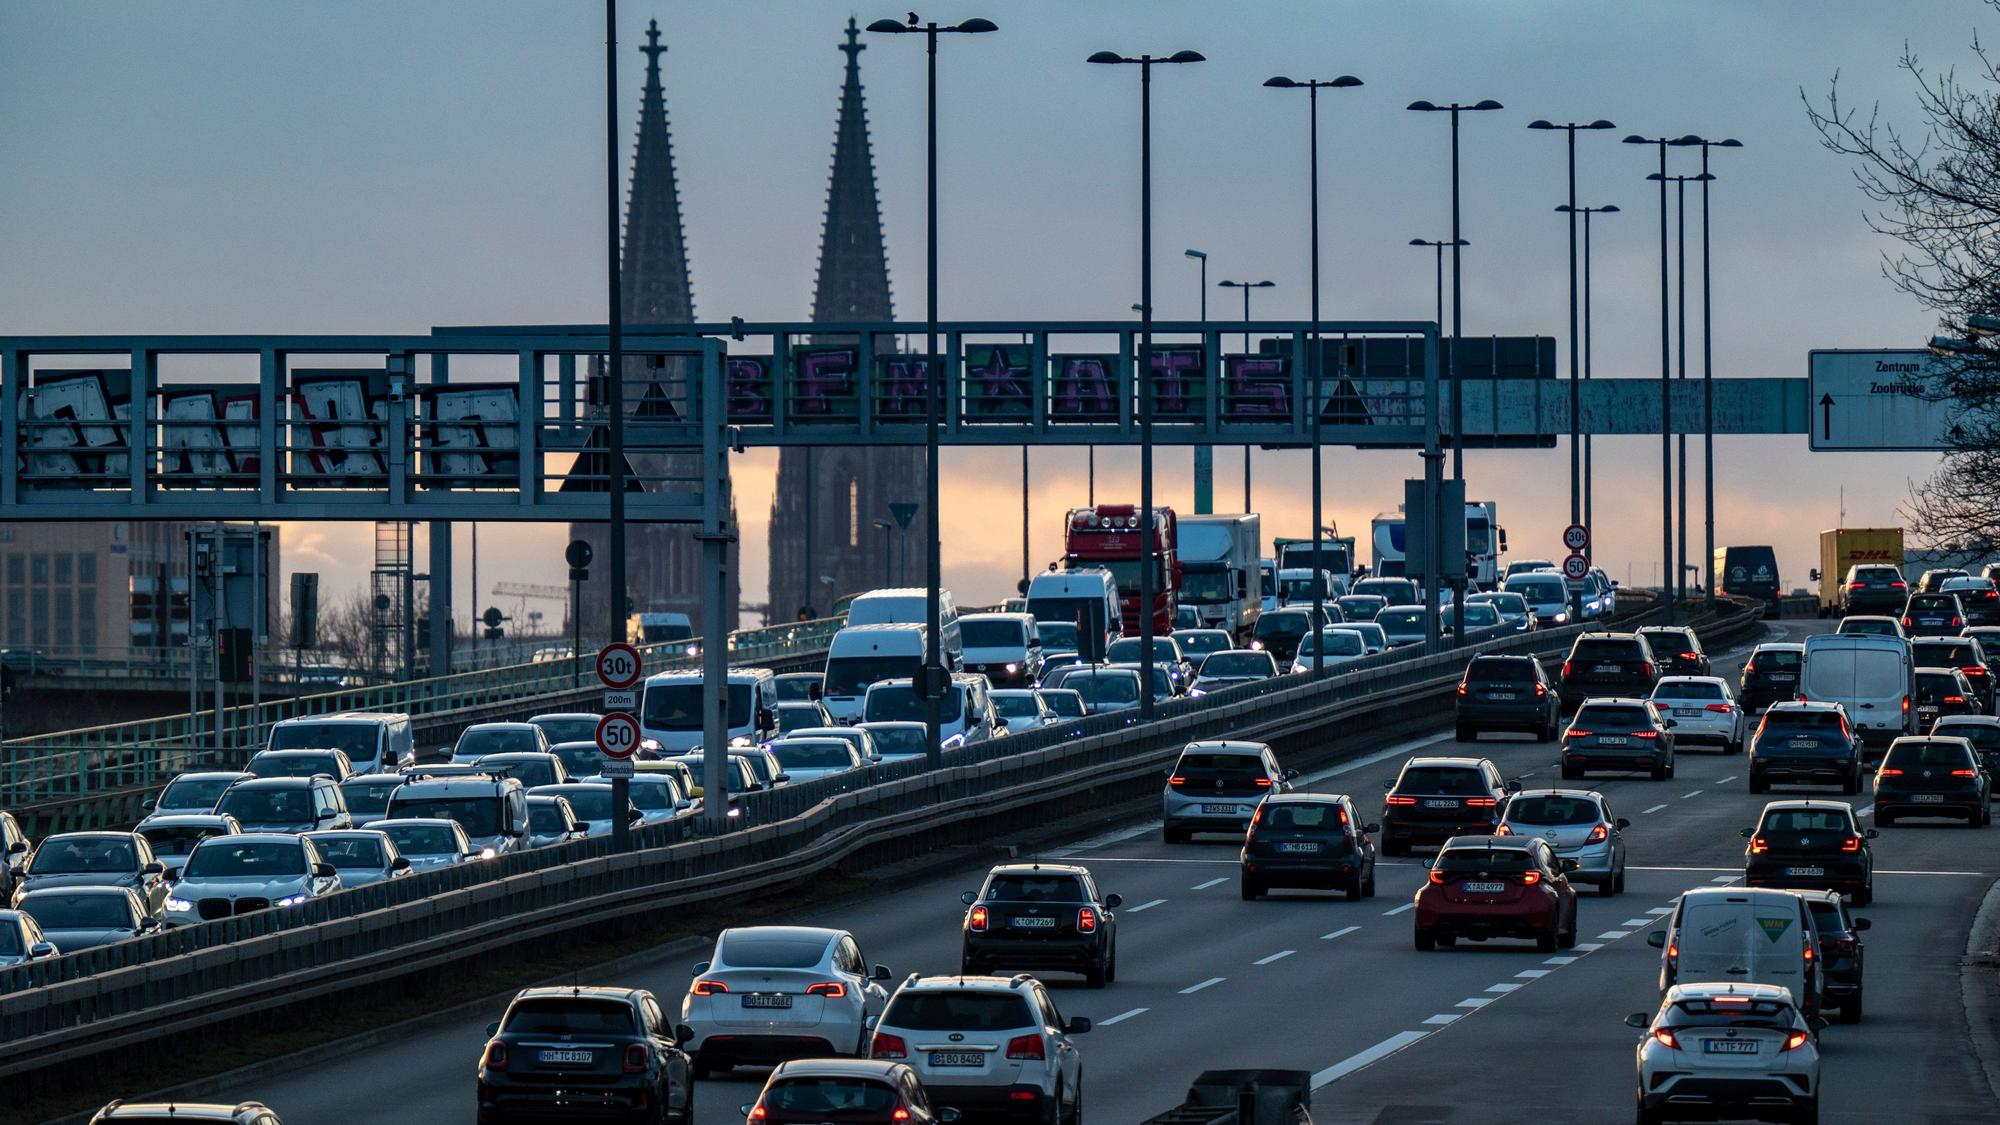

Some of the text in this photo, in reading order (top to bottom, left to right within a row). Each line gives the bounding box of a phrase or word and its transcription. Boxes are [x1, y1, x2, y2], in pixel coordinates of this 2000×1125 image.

[1876, 361, 1920, 372] Zentrum
[1568, 532, 1585, 542] 30t
[1849, 551, 1891, 560] DHL
[1569, 561, 1584, 573] 50
[603, 657, 632, 675] 30t
[608, 696, 632, 704] 200m
[607, 725, 632, 746] 50
